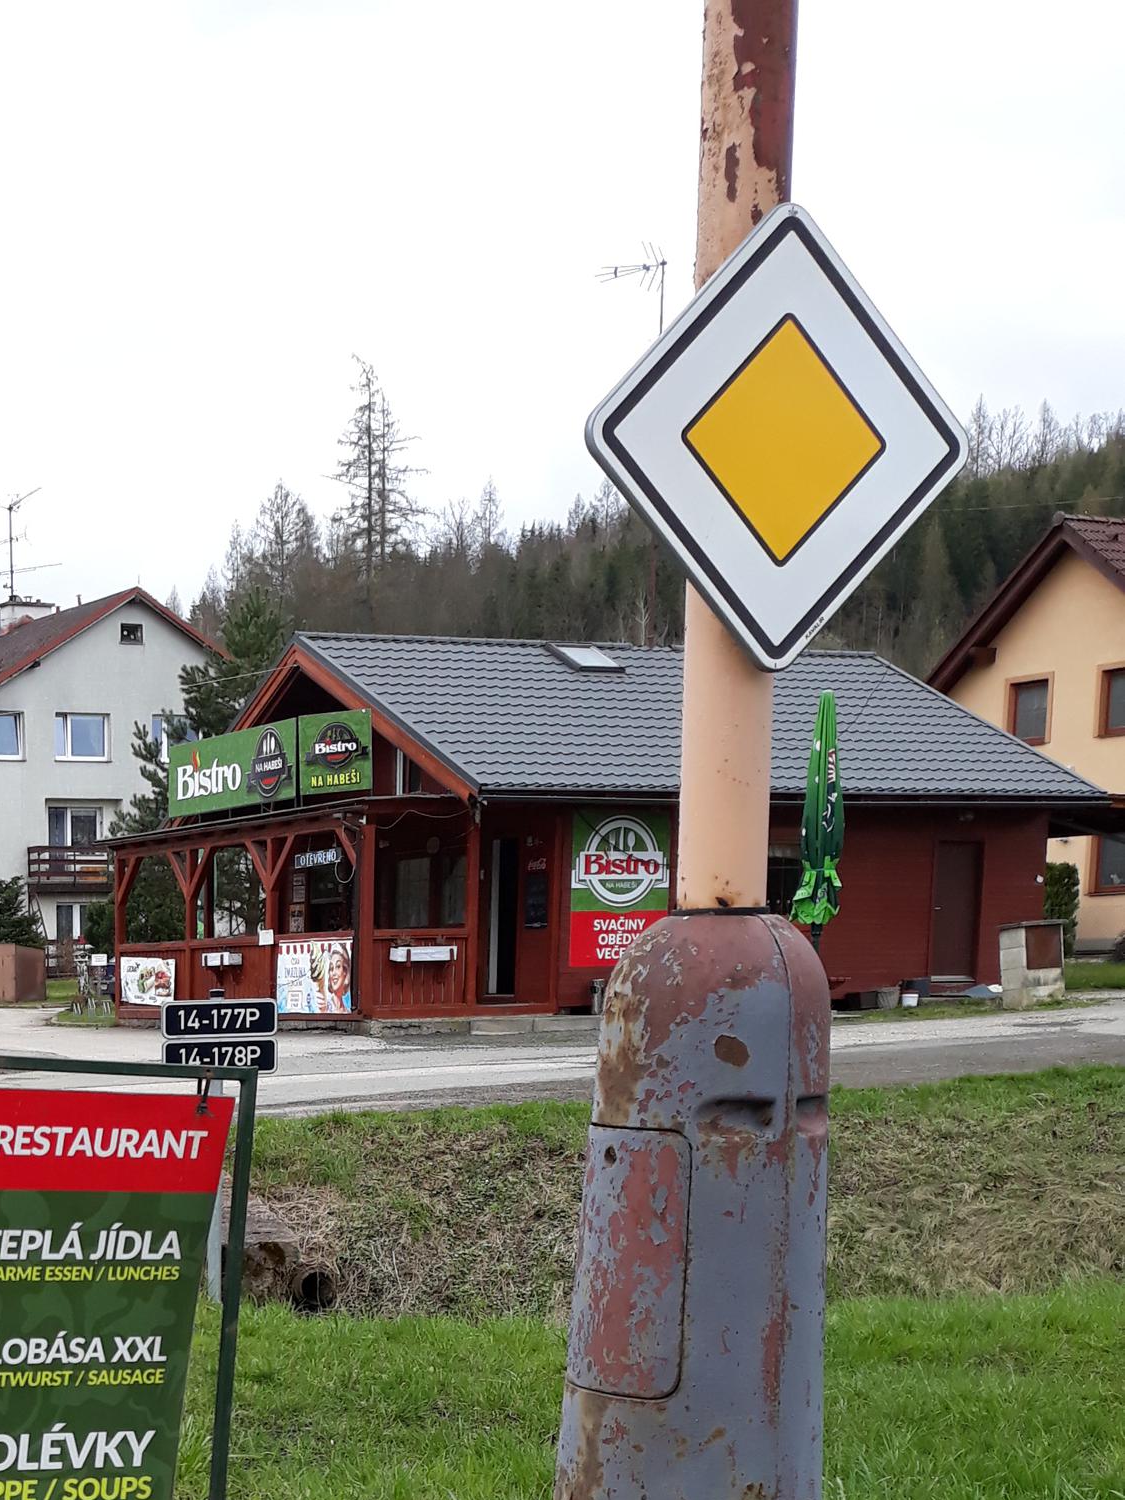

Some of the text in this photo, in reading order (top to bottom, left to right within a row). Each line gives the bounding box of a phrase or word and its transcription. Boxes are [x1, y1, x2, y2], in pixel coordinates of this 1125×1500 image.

[314, 739, 357, 755] Bistro
[177, 756, 242, 801] Bistro
[311, 769, 362, 789] NA HABEŠI
[584, 853, 660, 876] Bistro
[593, 916, 646, 931] SVAČINY
[178, 1008, 261, 1030] 14-177P
[179, 1045, 262, 1067] 14-178P
[89, 1222, 182, 1262] JÍDLA
[44, 1265, 94, 1283] ESSEN
[96, 1265, 105, 1283] /
[106, 1264, 181, 1282] LUNCHES
[110, 1336, 168, 1364] XXL
[75, 1369, 85, 1388] /
[86, 1368, 166, 1386] SAUSAGE
